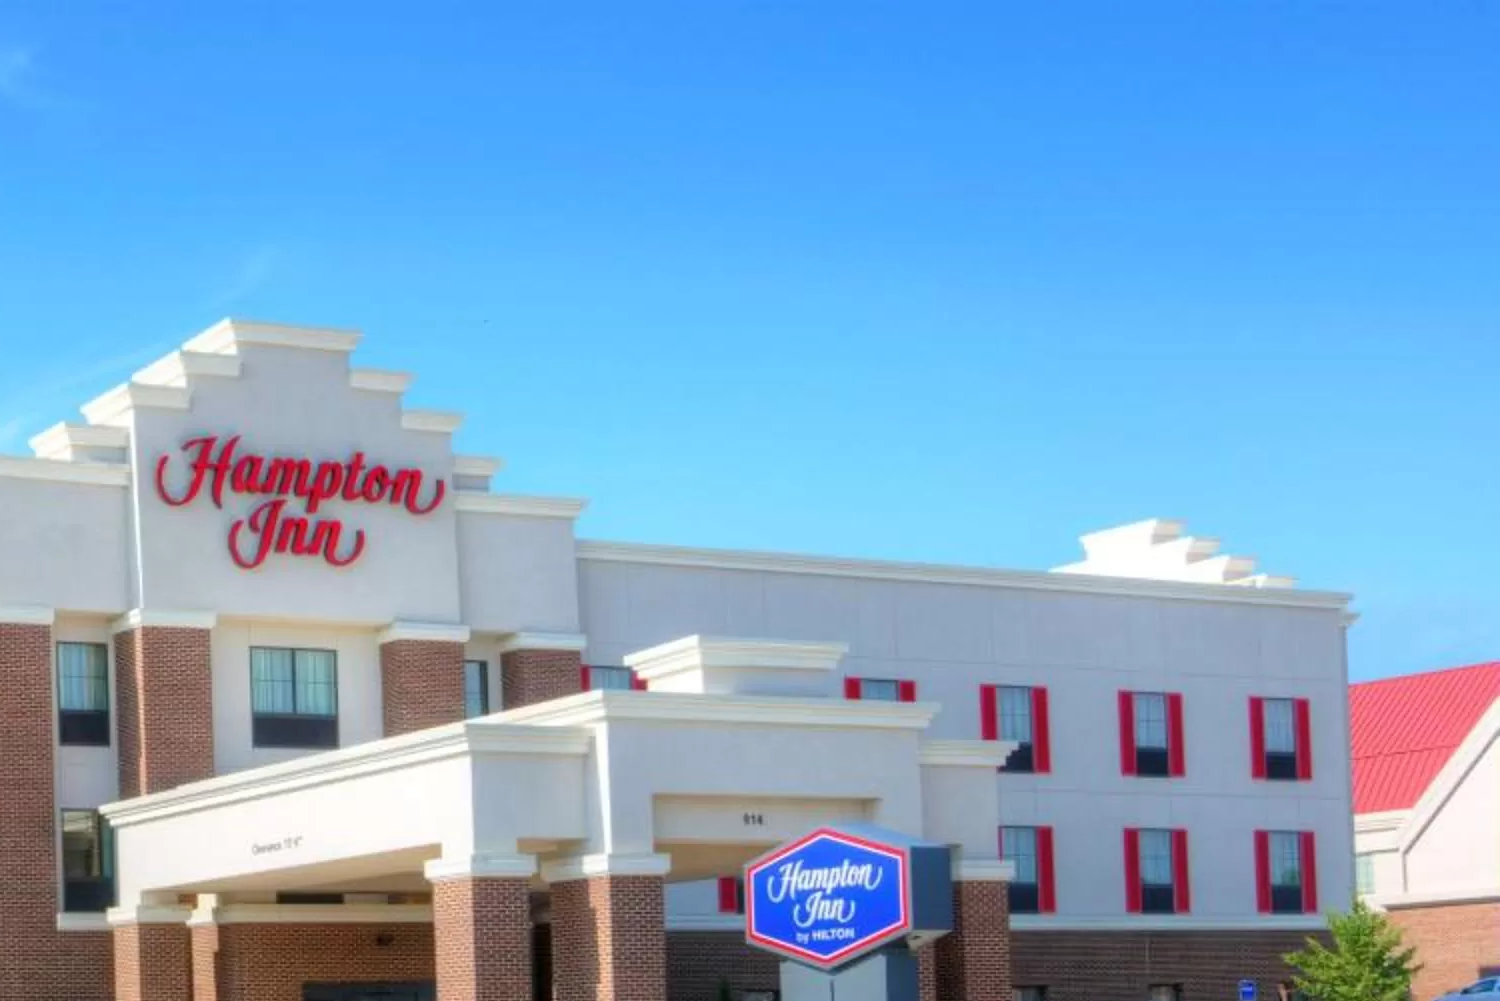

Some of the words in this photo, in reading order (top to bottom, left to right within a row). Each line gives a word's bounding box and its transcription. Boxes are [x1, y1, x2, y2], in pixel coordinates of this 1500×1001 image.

[156, 435, 445, 515] Hampton
[227, 499, 366, 569] Inn
[767, 859, 883, 903] Hampton
[793, 891, 855, 928] Inn
[797, 933, 809, 944] by
[811, 927, 854, 941] HILTON
